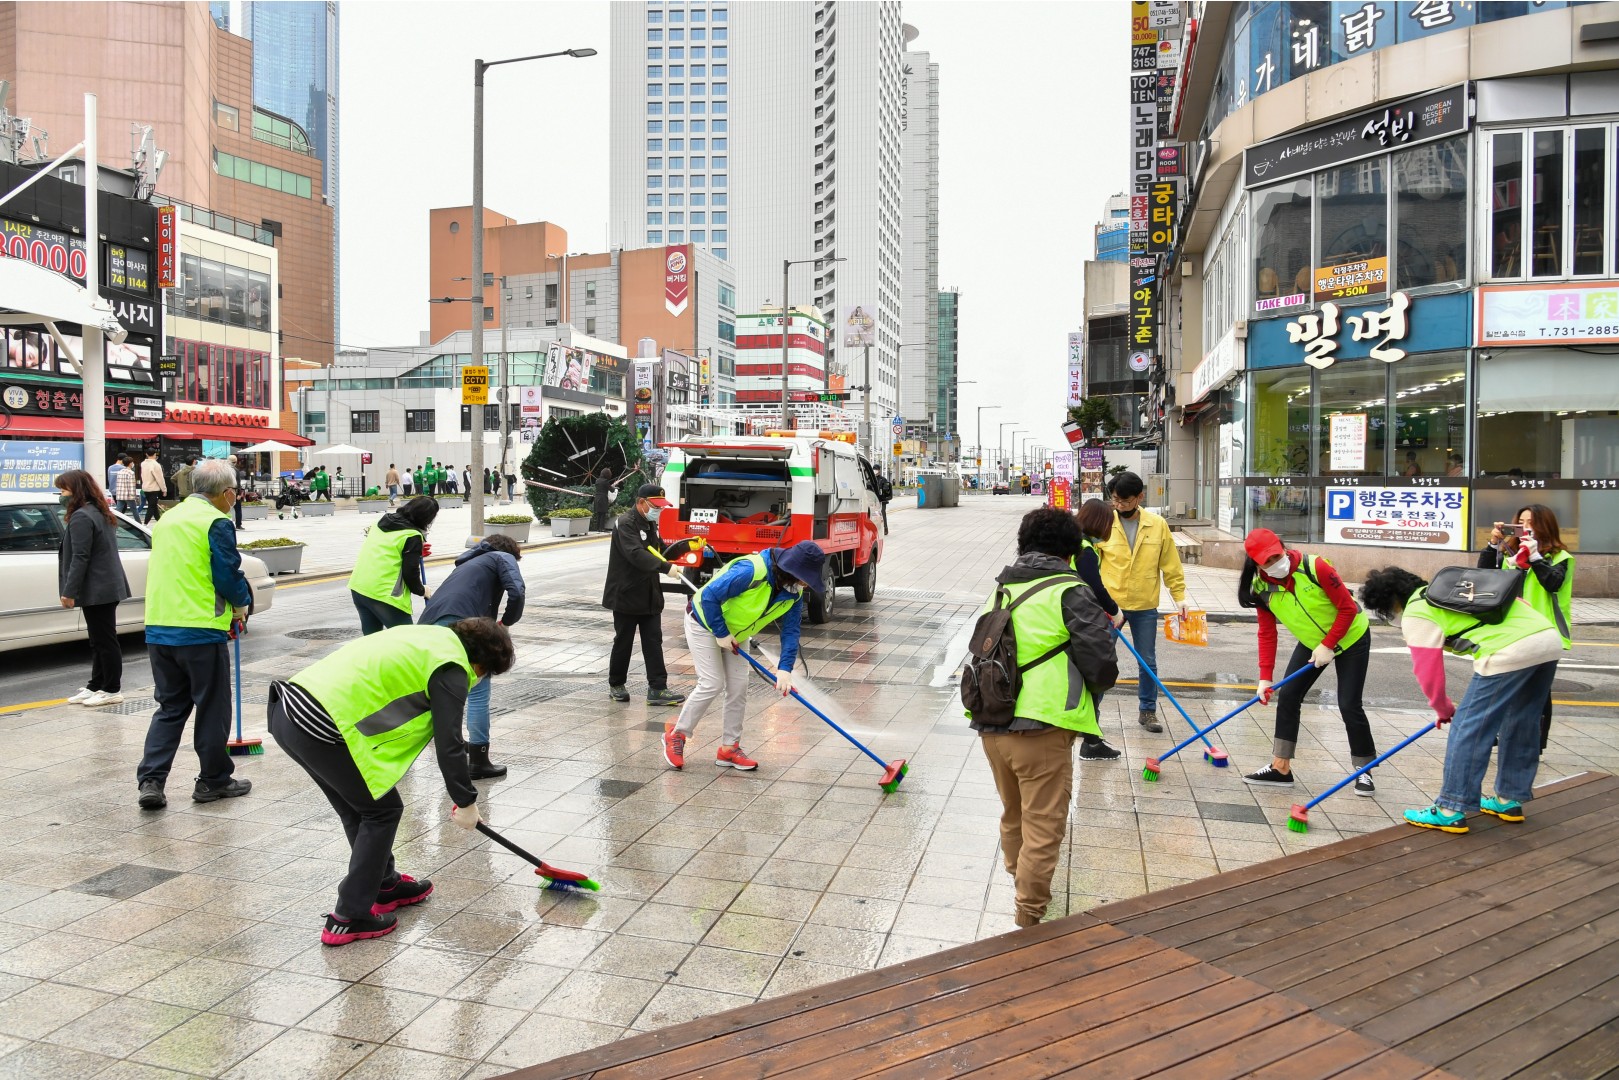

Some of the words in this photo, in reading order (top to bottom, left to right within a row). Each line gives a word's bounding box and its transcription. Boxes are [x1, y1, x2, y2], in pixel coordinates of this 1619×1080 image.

[1156, 17, 1172, 25] 5F
[1132, 46, 1156, 58] 747-
[1132, 57, 1156, 68] 3153
[1132, 76, 1156, 89] TOP
[1132, 90, 1156, 102] TEN
[1422, 106, 1452, 120] DESSERT
[1425, 100, 1452, 113] KOREAN
[1361, 109, 1414, 146] 설빙
[1158, 166, 1178, 174] BAR
[1151, 184, 1174, 244] 궁타이
[4, 220, 32, 238] 1시간
[162, 214, 173, 282] 타이마사지
[666, 274, 686, 283] 버거킹
[1318, 269, 1385, 290] 행운타워주차장
[1346, 286, 1368, 296] 50M
[1256, 297, 1281, 310] TAKE
[1284, 294, 1304, 306] OUT
[1133, 287, 1152, 344] 야구존
[1286, 292, 1411, 370] 밀면
[1070, 370, 1080, 402] 낙곱새
[213, 412, 270, 427] PASCUCCI
[1332, 494, 1351, 516] P
[1358, 490, 1465, 510] 행운주차장
[1397, 520, 1429, 528] 30M
[1431, 520, 1454, 529] 타워
